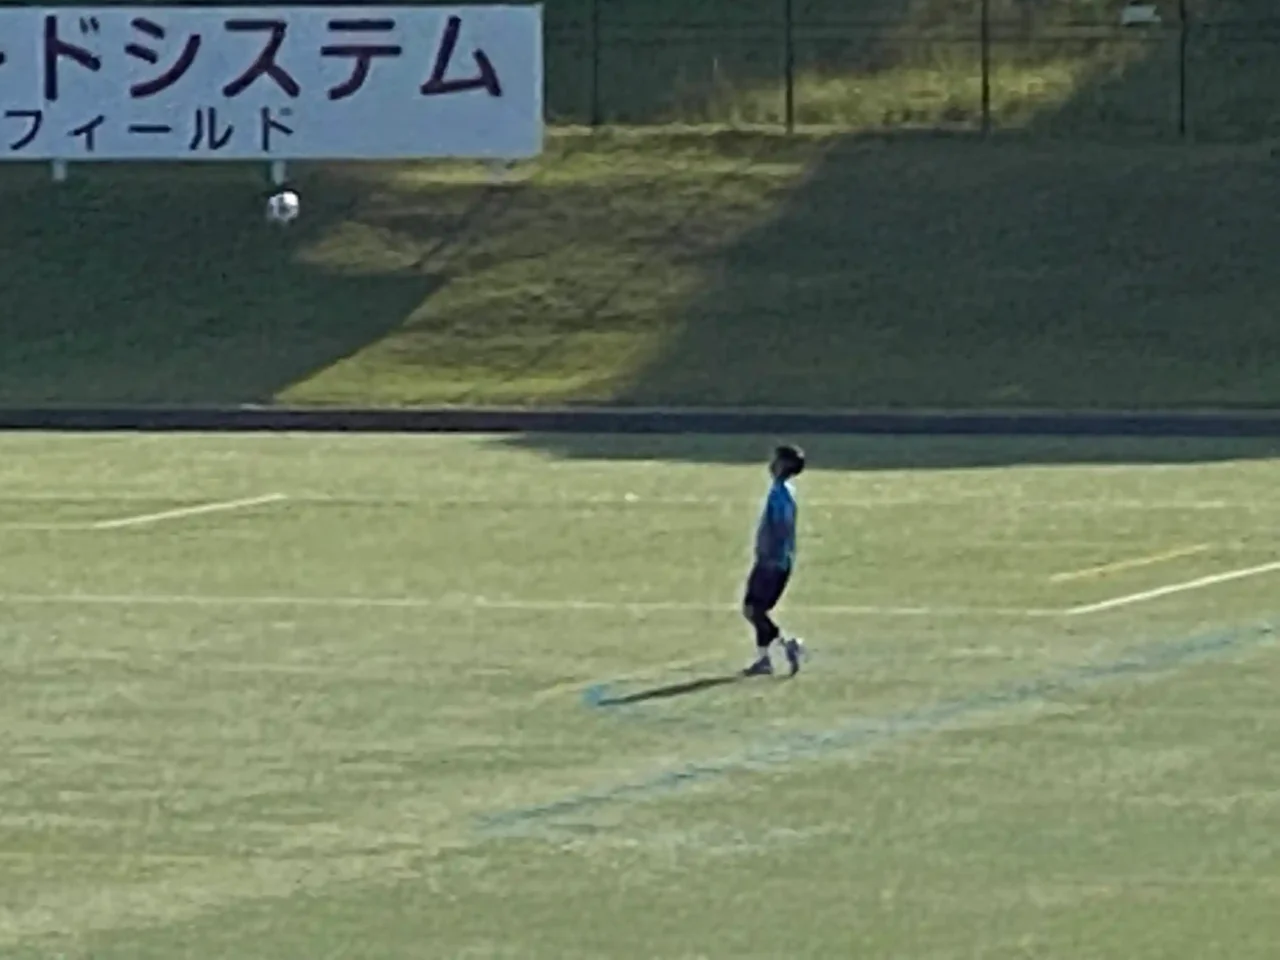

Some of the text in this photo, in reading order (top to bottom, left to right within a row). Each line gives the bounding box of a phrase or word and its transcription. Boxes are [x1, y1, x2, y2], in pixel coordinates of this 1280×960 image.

[4, 107, 295, 153] フィールド
